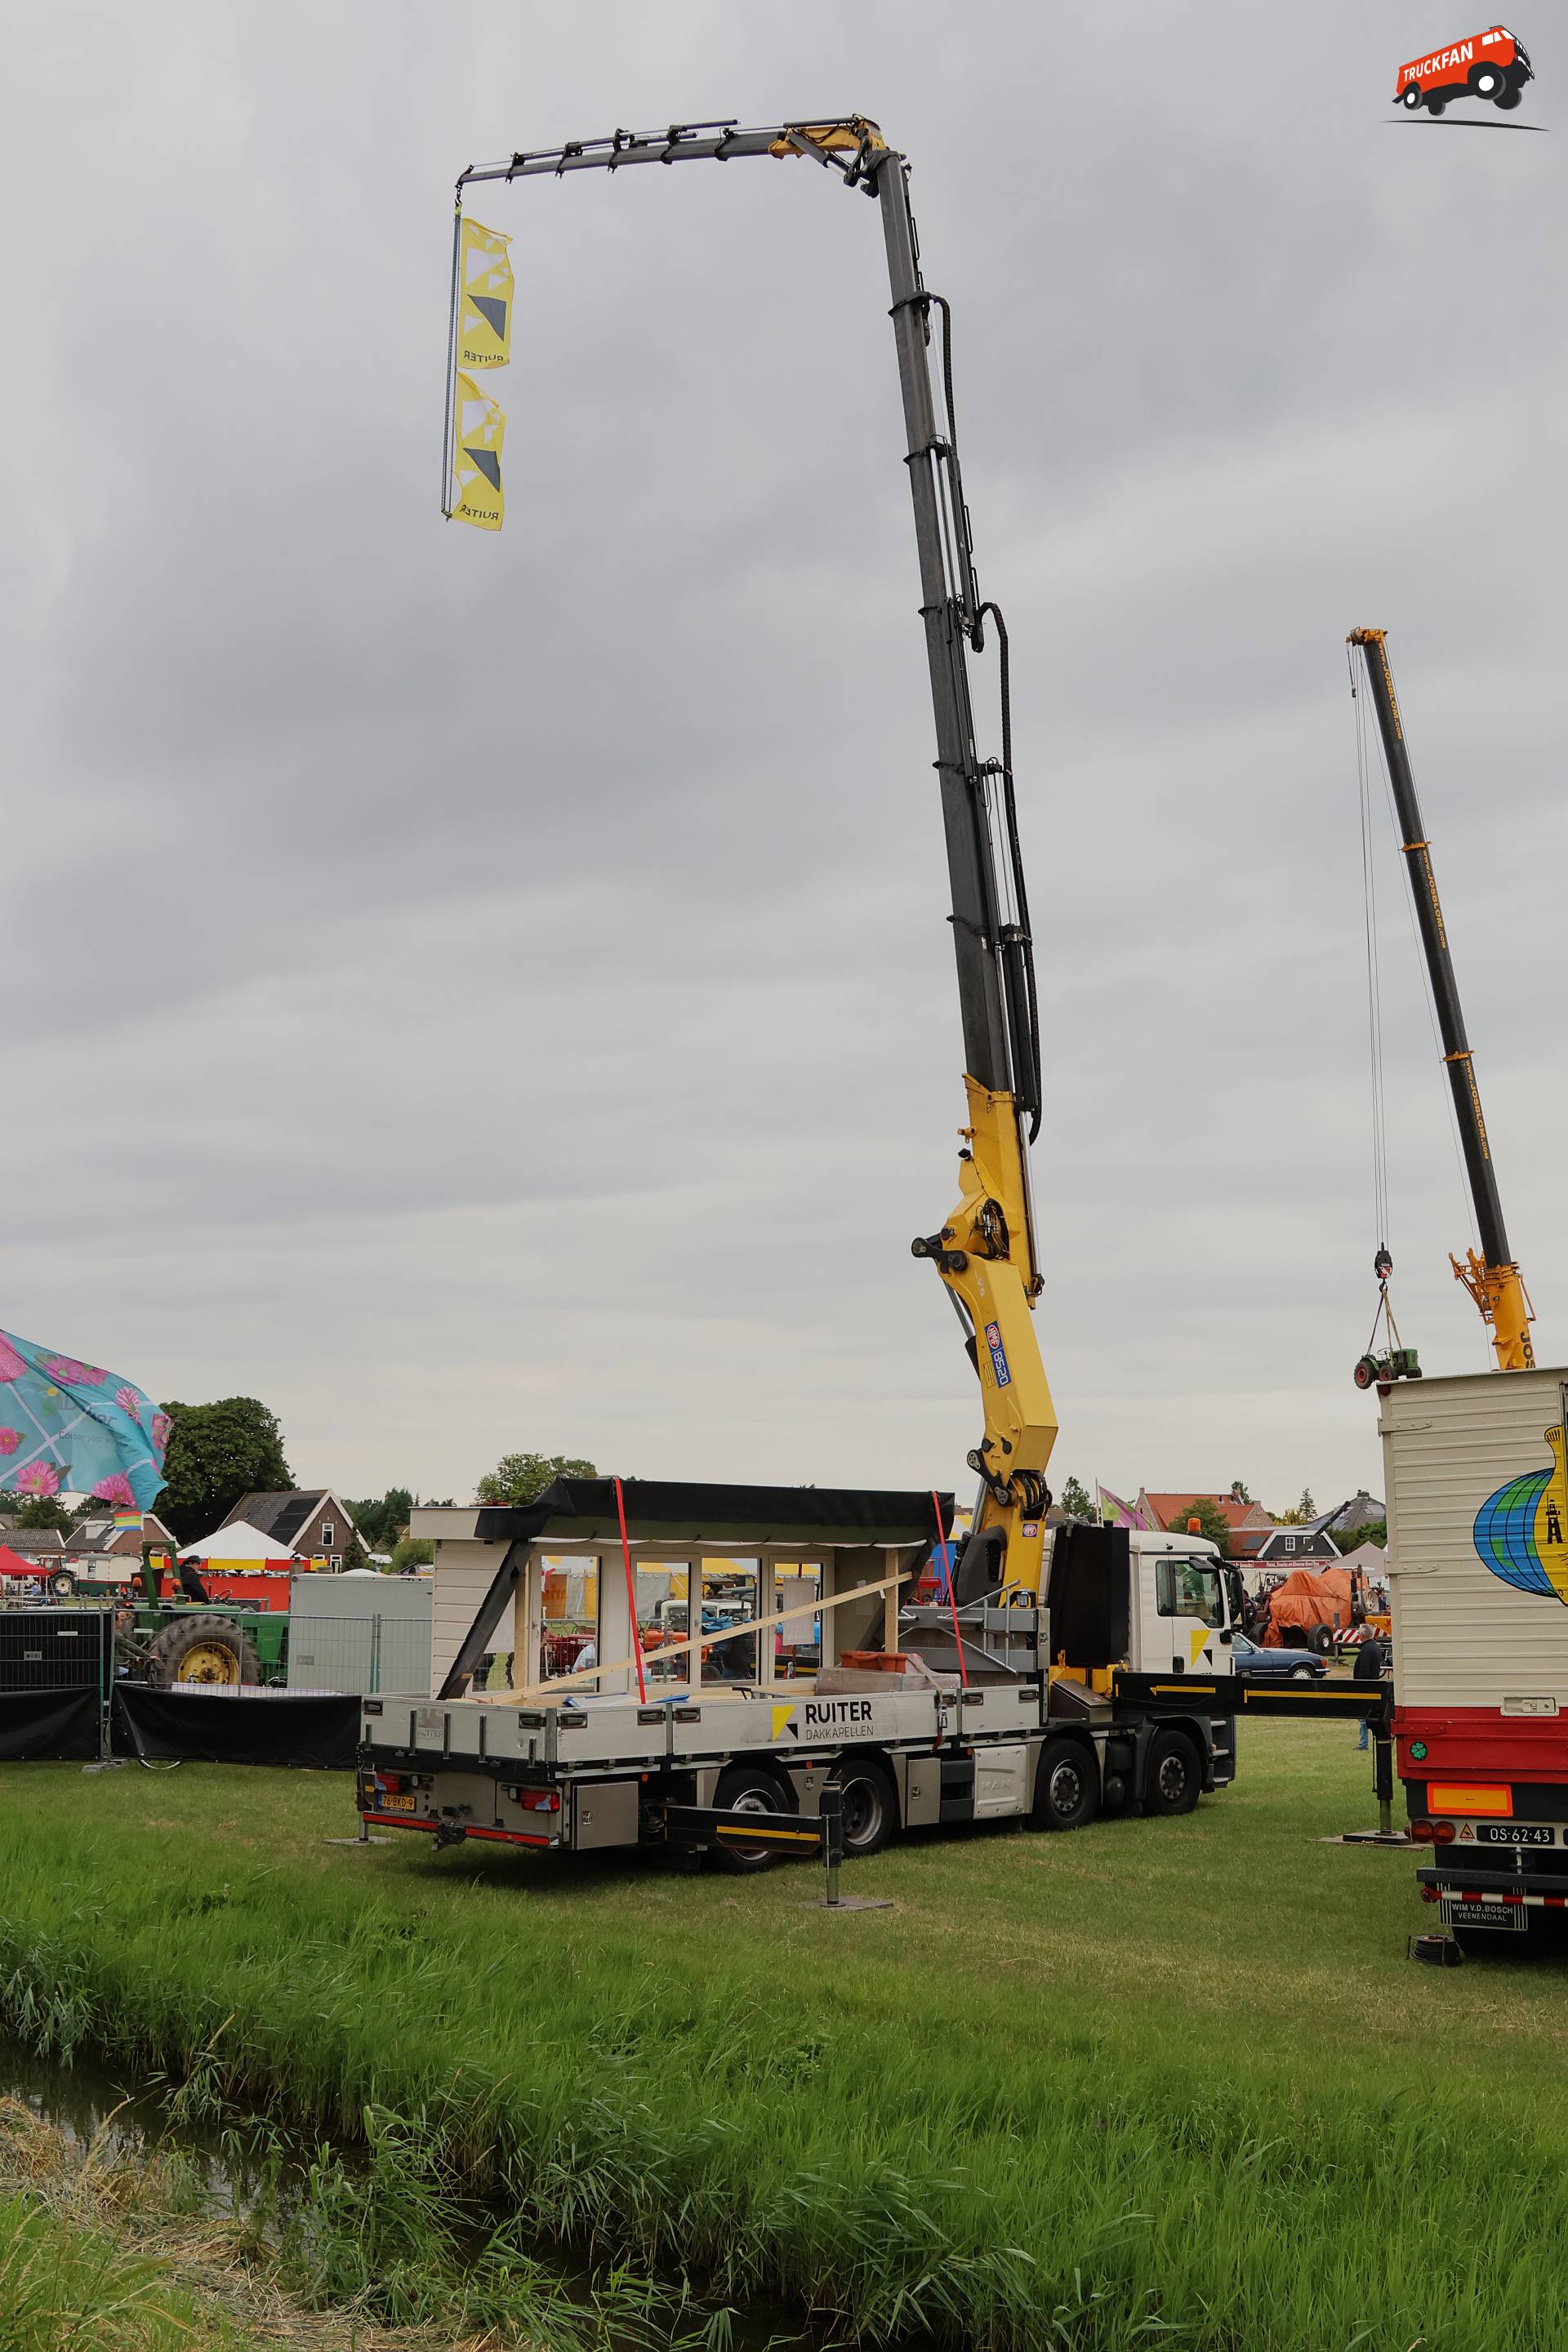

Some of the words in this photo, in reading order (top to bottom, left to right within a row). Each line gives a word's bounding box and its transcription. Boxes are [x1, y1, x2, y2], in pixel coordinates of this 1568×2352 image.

[993, 1351, 1009, 1386] 8520
[805, 1700, 873, 1725] RUITER
[806, 1725, 874, 1740] DAKKAPELLEN
[1452, 1903, 1468, 1912] WIM
[1458, 1912, 1508, 1922] VEENENDAAL
